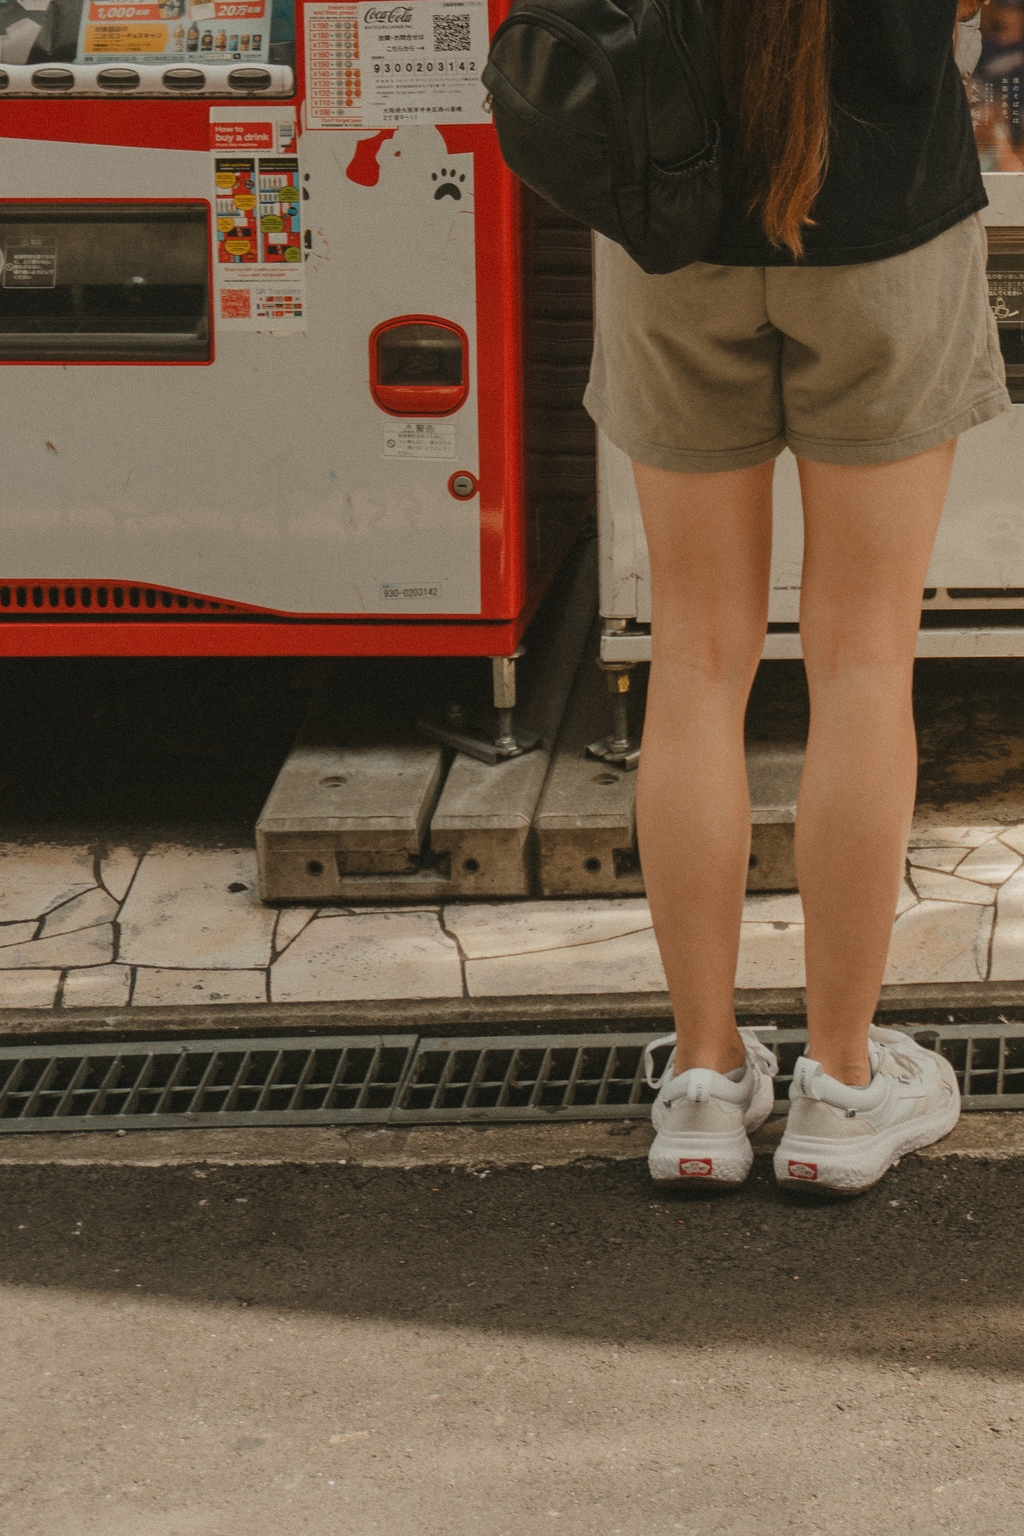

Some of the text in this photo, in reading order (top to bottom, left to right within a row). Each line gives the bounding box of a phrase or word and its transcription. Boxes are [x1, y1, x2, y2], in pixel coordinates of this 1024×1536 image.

[364, 6, 414, 23] Coca-Cola
[215, 133, 233, 142] buy
[244, 133, 269, 141] drink
